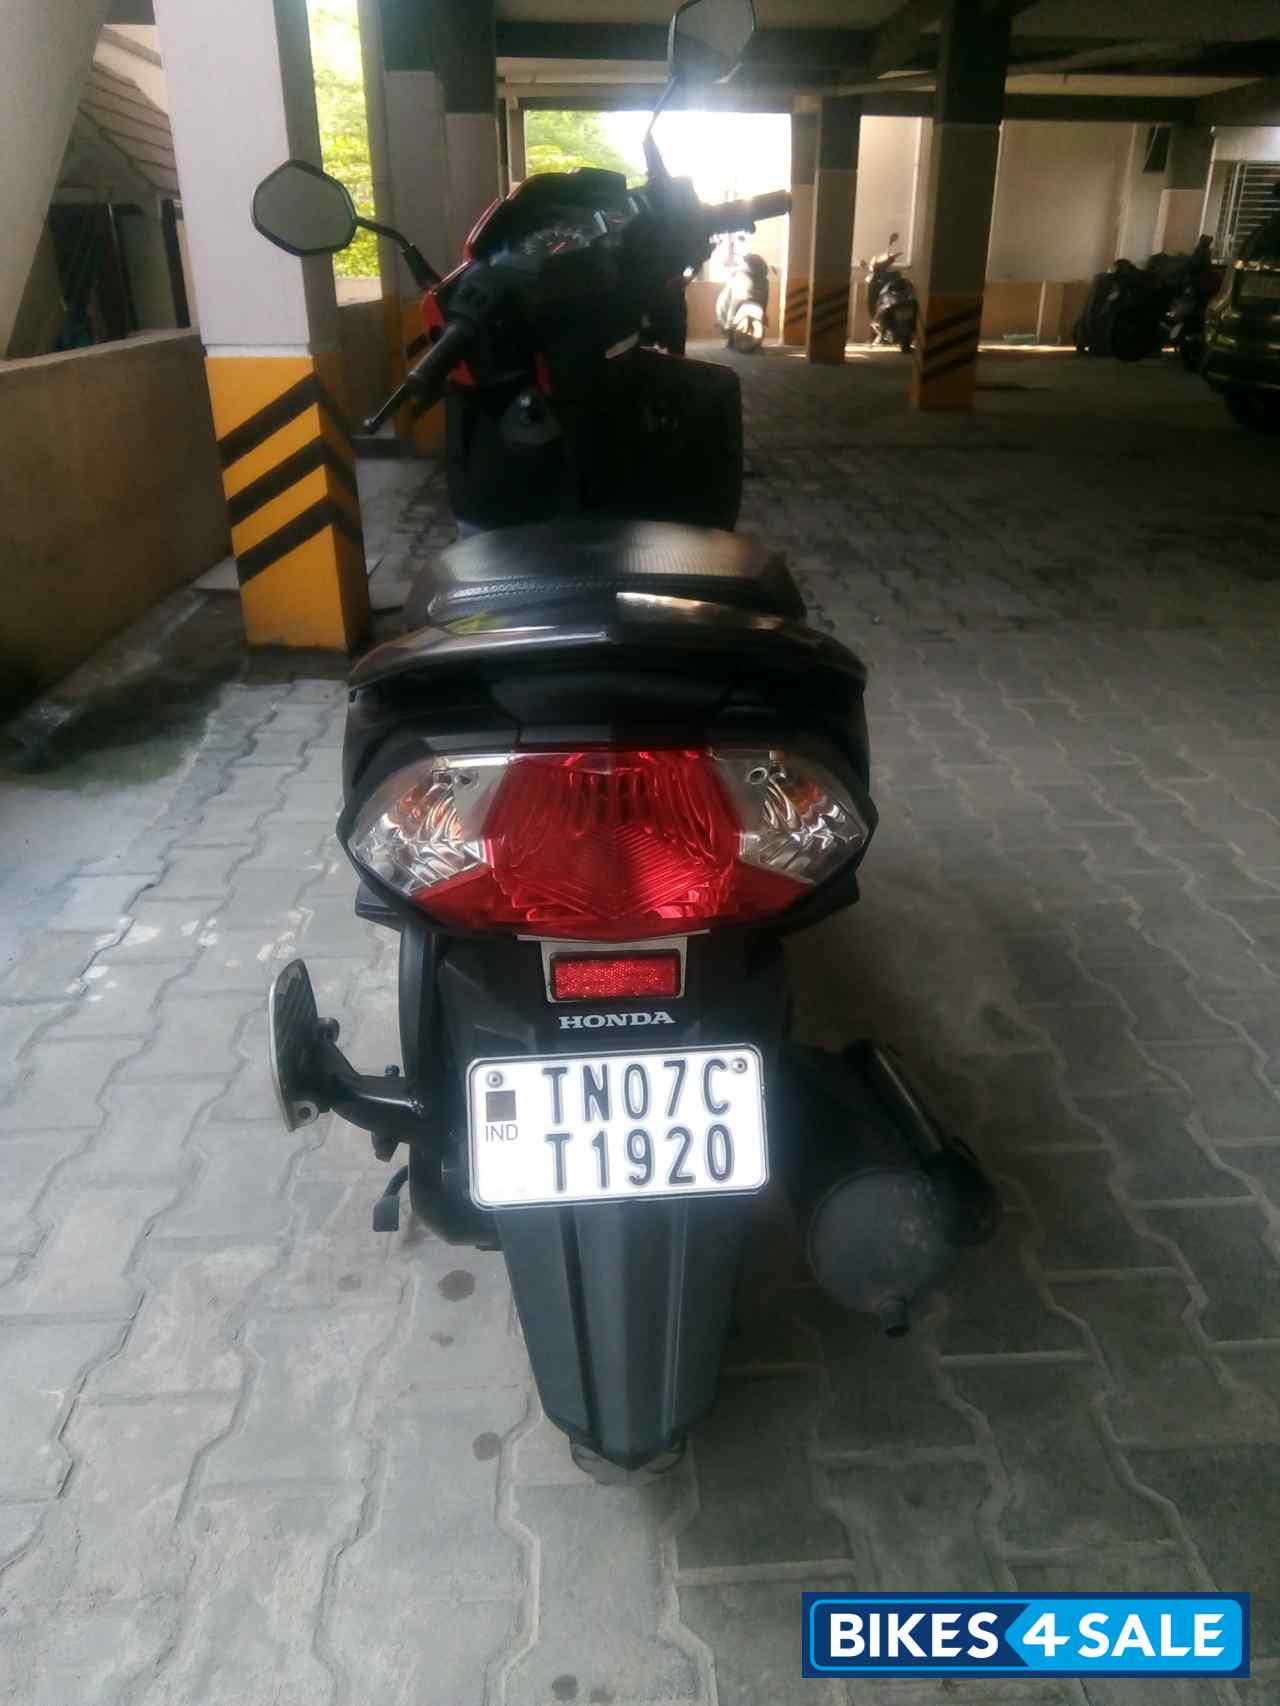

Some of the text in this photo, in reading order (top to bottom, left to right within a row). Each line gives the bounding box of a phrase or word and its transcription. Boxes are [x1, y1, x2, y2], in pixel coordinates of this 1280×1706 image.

[558, 1011, 676, 1030] HONDA
[542, 1058, 730, 1125] TN07C
[485, 1124, 519, 1143] IND
[543, 1123, 735, 1193] T1920
